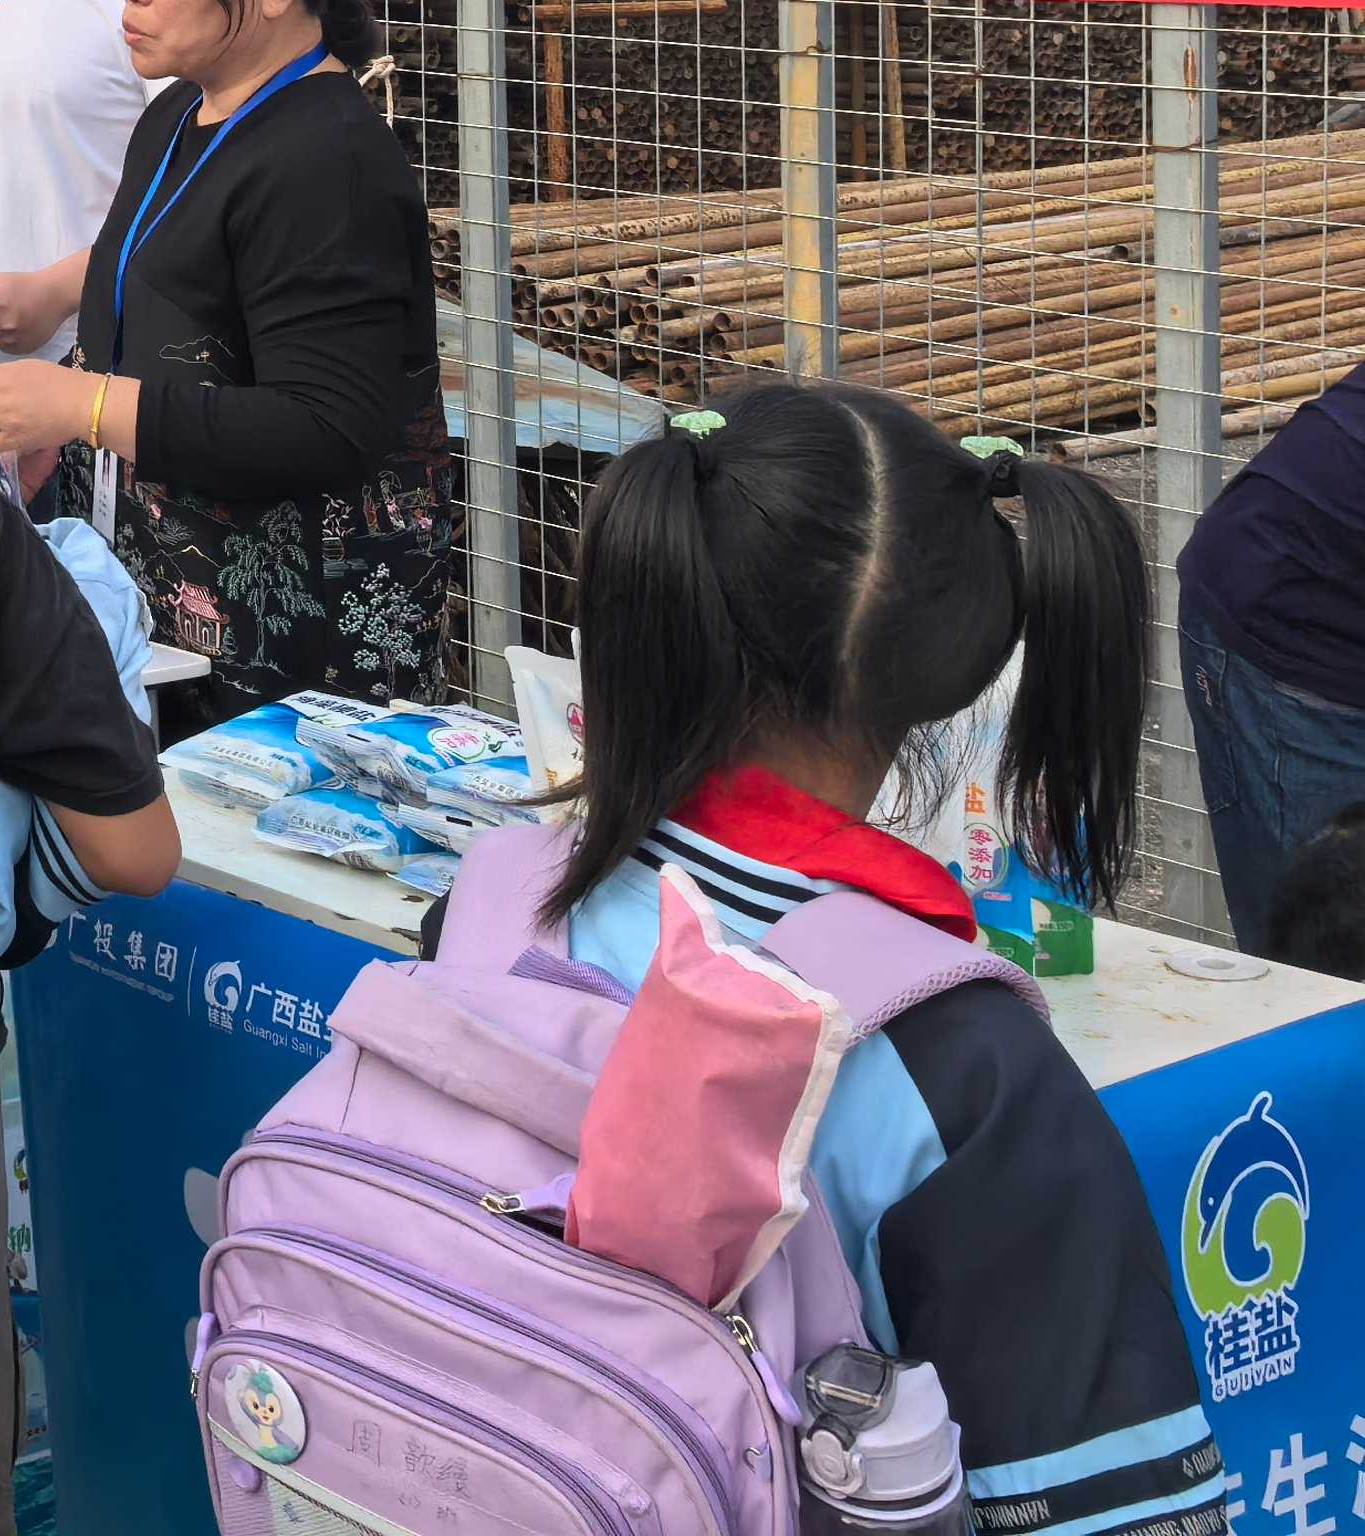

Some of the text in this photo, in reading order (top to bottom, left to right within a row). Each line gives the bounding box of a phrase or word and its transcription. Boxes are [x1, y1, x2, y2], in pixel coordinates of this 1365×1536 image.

[969, 827, 994, 881] 零添加
[243, 1018, 289, 1048] Guangxi
[291, 1035, 314, 1058] Salt
[1207, 1298, 1299, 1380] 桂盐
[1214, 1355, 1297, 1399] GUIYAN
